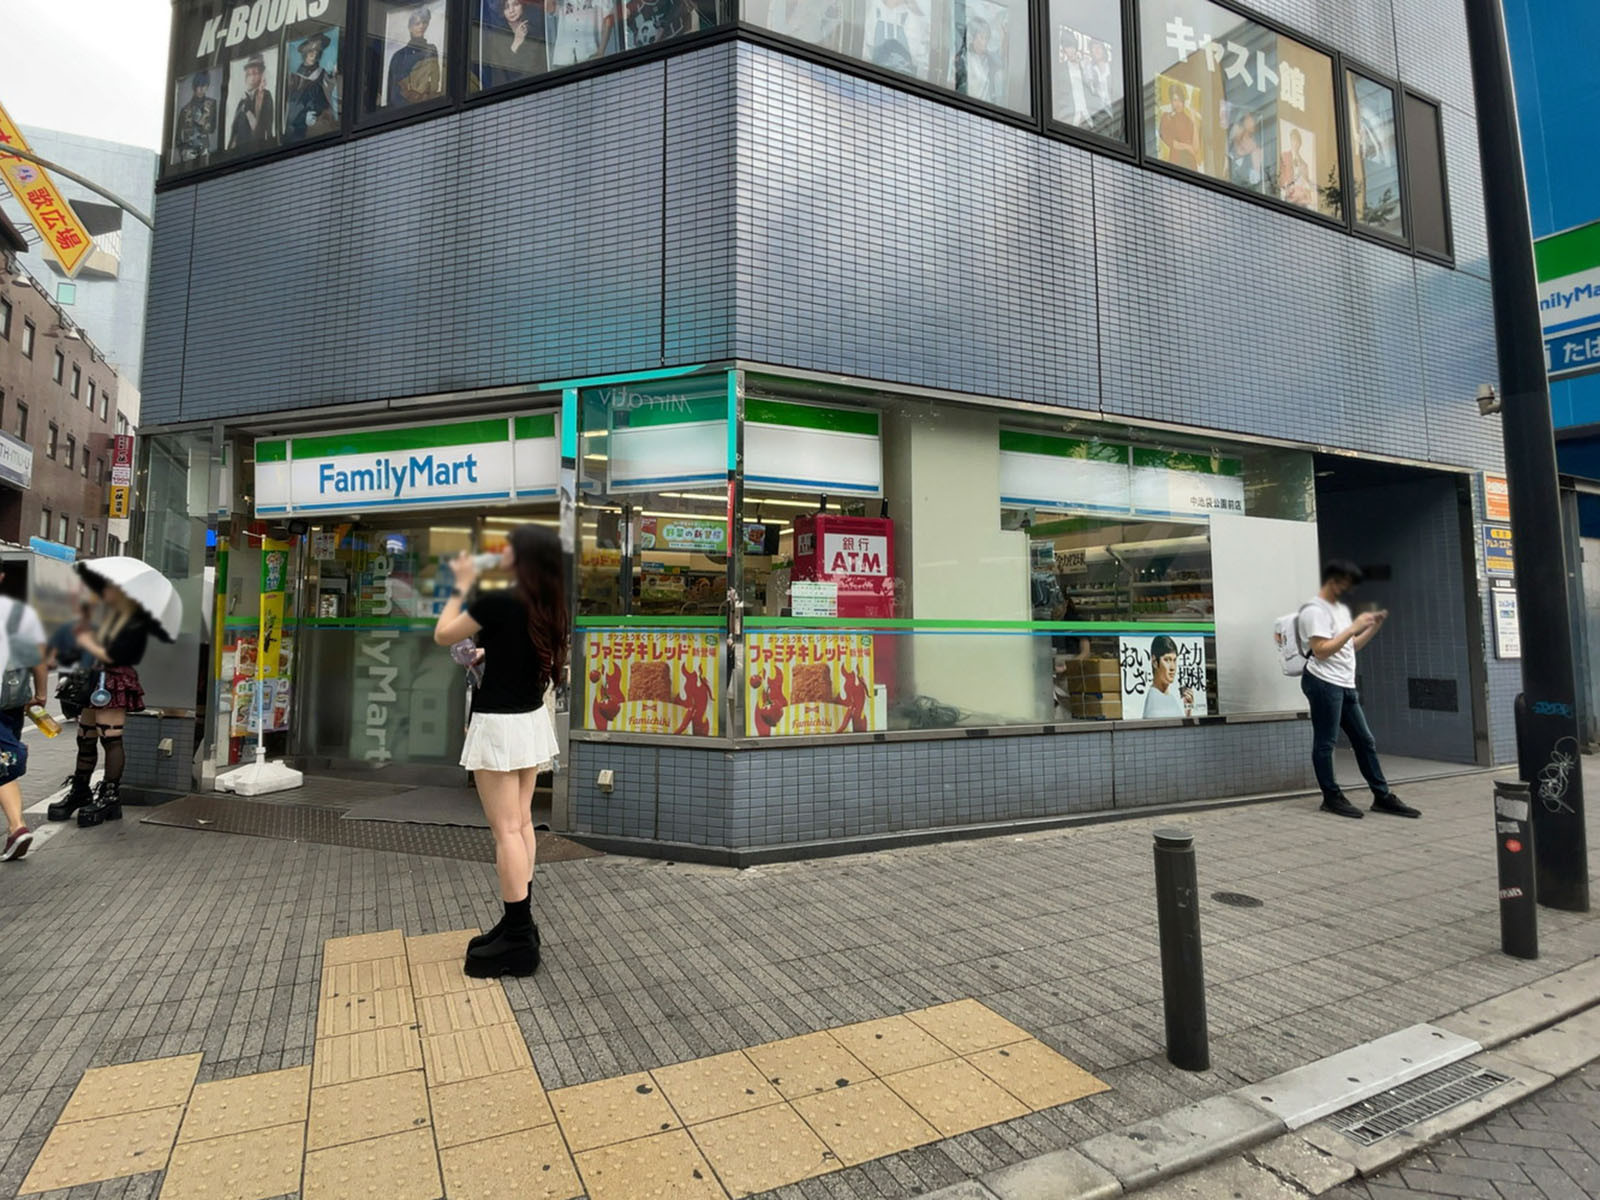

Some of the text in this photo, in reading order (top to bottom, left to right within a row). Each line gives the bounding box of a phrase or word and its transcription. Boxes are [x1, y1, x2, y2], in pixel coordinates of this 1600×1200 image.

[1165, 16, 1306, 113] キャスト館
[26, 186, 83, 250] 歌広場
[319, 453, 478, 497] FamilyMart
[830, 551, 882, 573] ATM
[841, 536, 870, 551] 銀行
